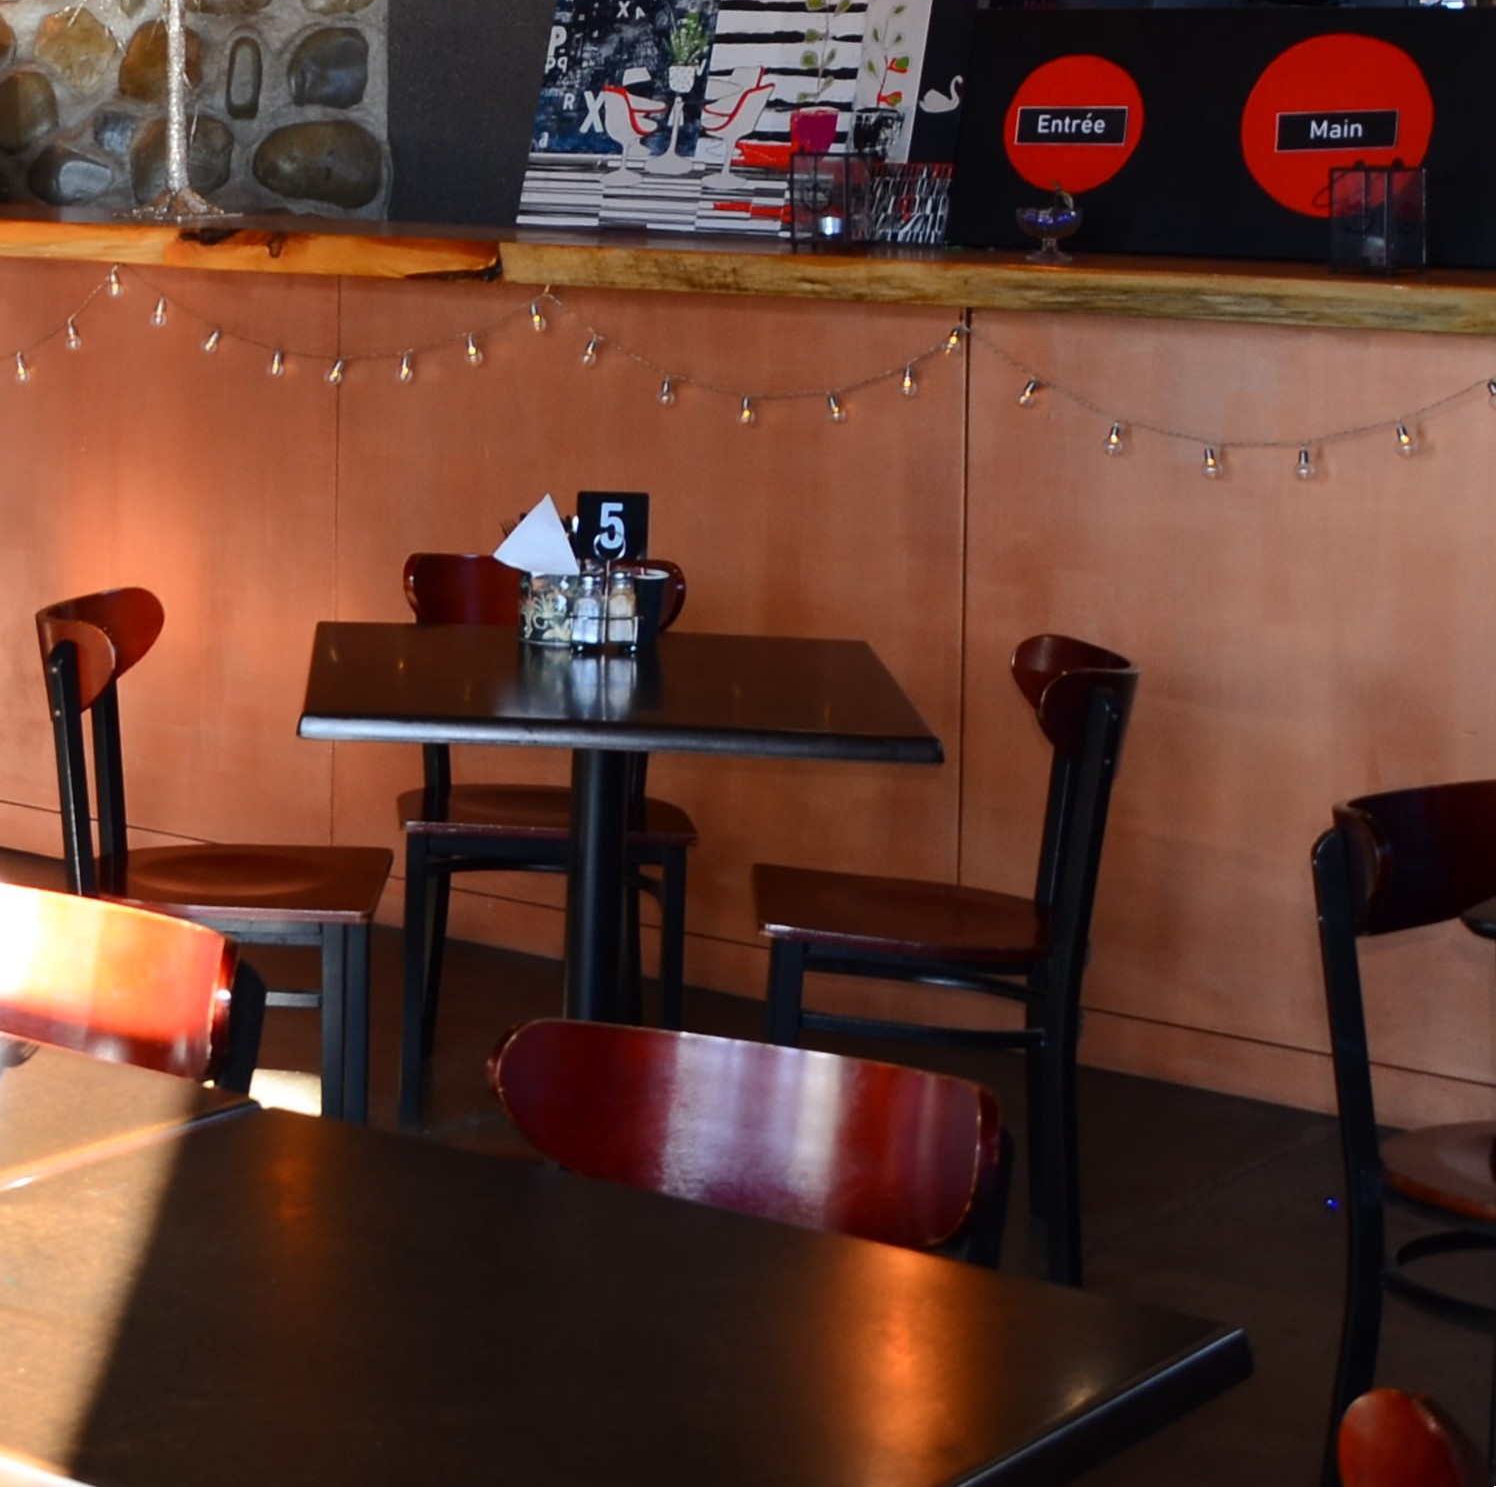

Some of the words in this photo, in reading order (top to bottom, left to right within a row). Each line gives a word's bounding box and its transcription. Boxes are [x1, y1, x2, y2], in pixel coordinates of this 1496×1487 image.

[579, 90, 605, 133] X
[1037, 112, 1106, 135] Entrée
[1310, 120, 1363, 140] Main
[599, 502, 625, 549] 5
